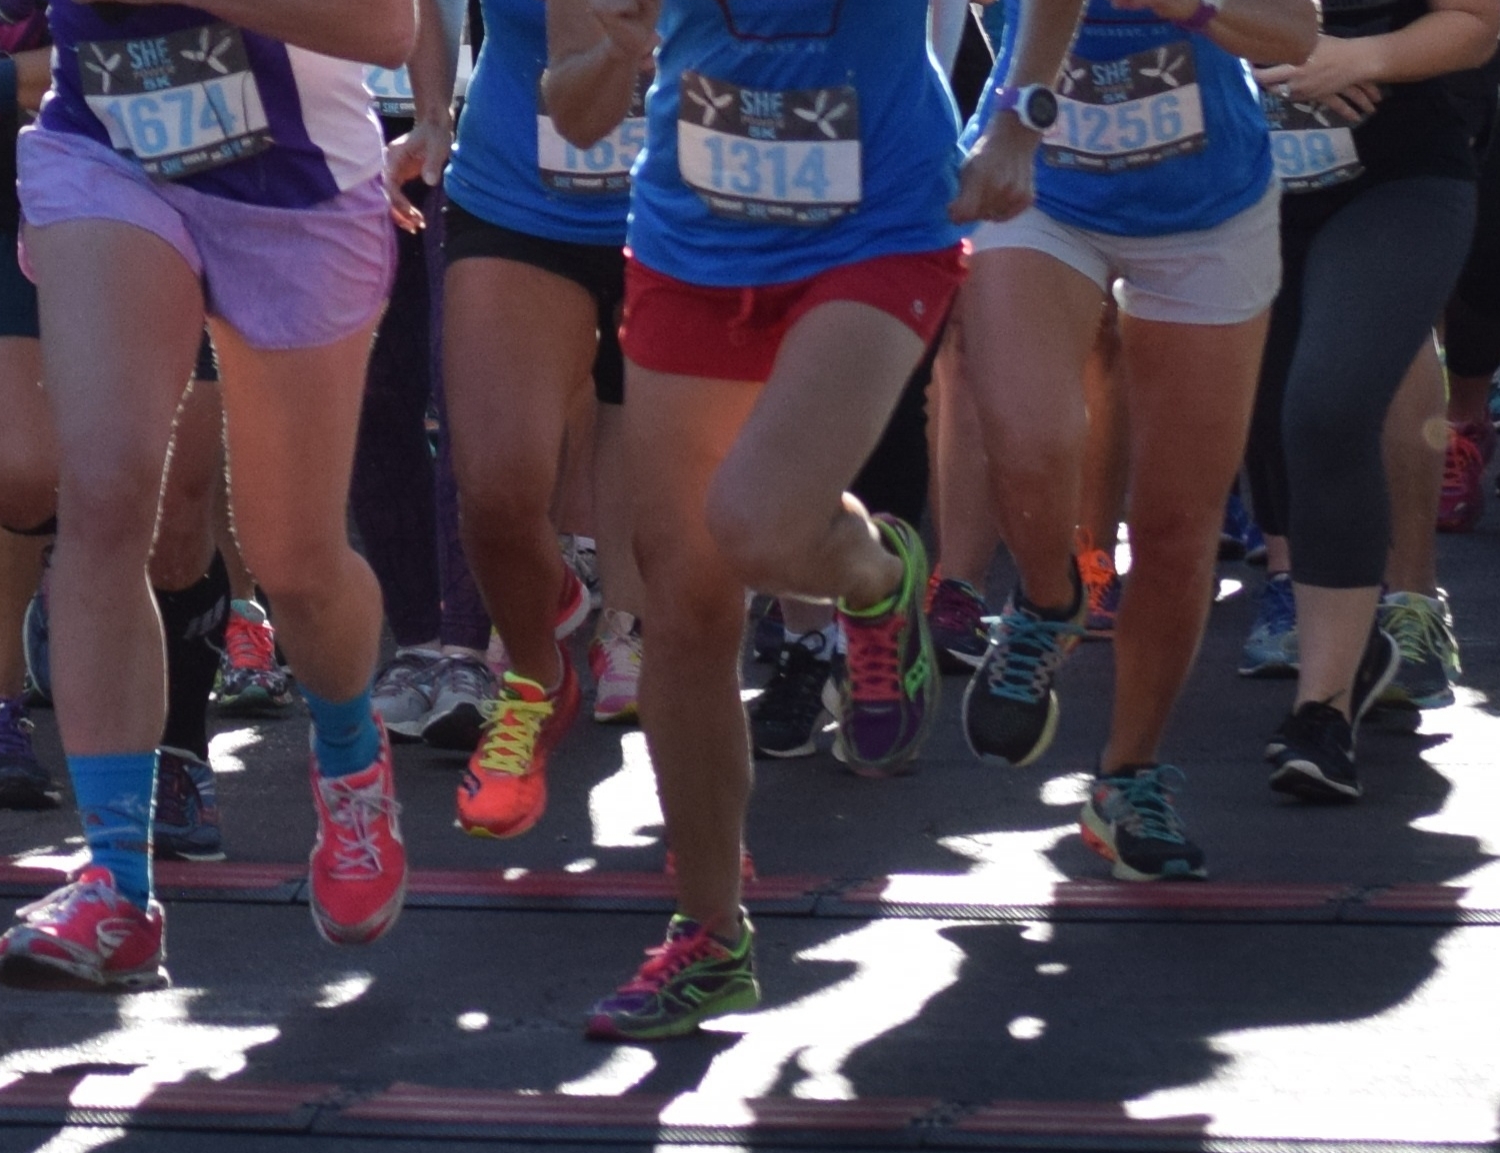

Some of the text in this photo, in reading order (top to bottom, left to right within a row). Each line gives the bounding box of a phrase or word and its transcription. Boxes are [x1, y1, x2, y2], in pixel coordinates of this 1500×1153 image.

[127, 38, 171, 70] SHE
[1092, 59, 1131, 86] SHE
[107, 83, 238, 155] 1674
[740, 89, 784, 118] SHE
[1058, 94, 1183, 151] 1256
[705, 135, 831, 199] 1314
